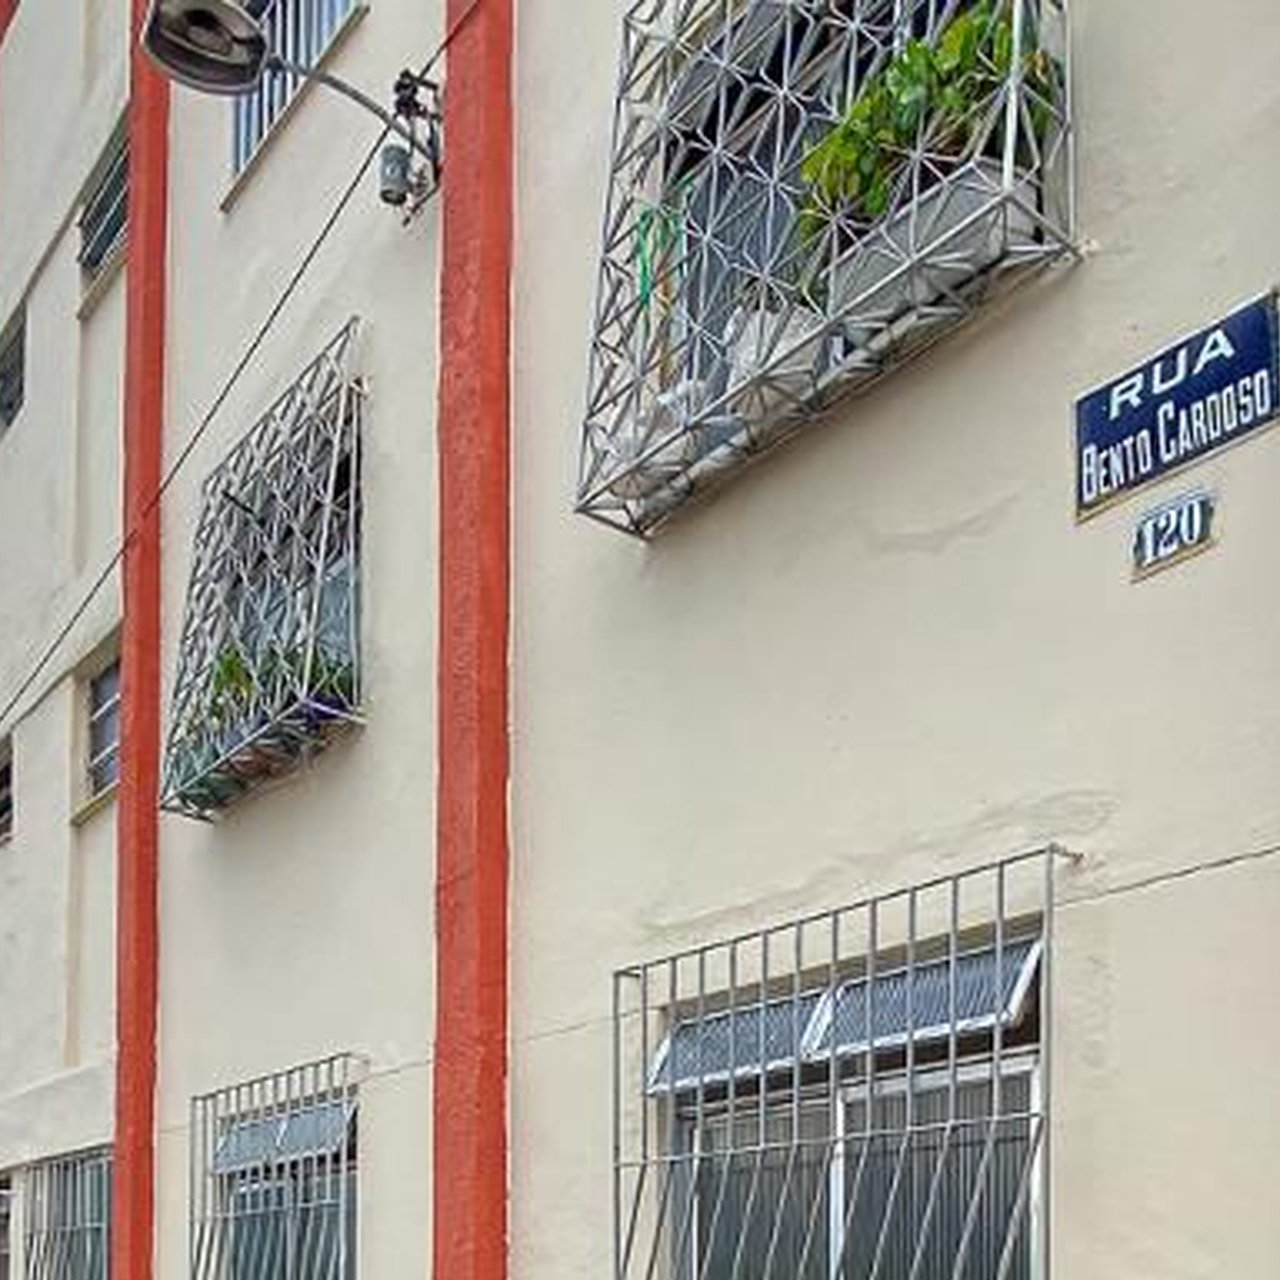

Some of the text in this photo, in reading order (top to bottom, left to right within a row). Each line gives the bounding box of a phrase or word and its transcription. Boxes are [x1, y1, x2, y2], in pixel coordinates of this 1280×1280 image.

[1108, 329, 1235, 421] RUA
[1081, 369, 1271, 503] BENTO CARDOSO
[1141, 498, 1202, 567] 120
